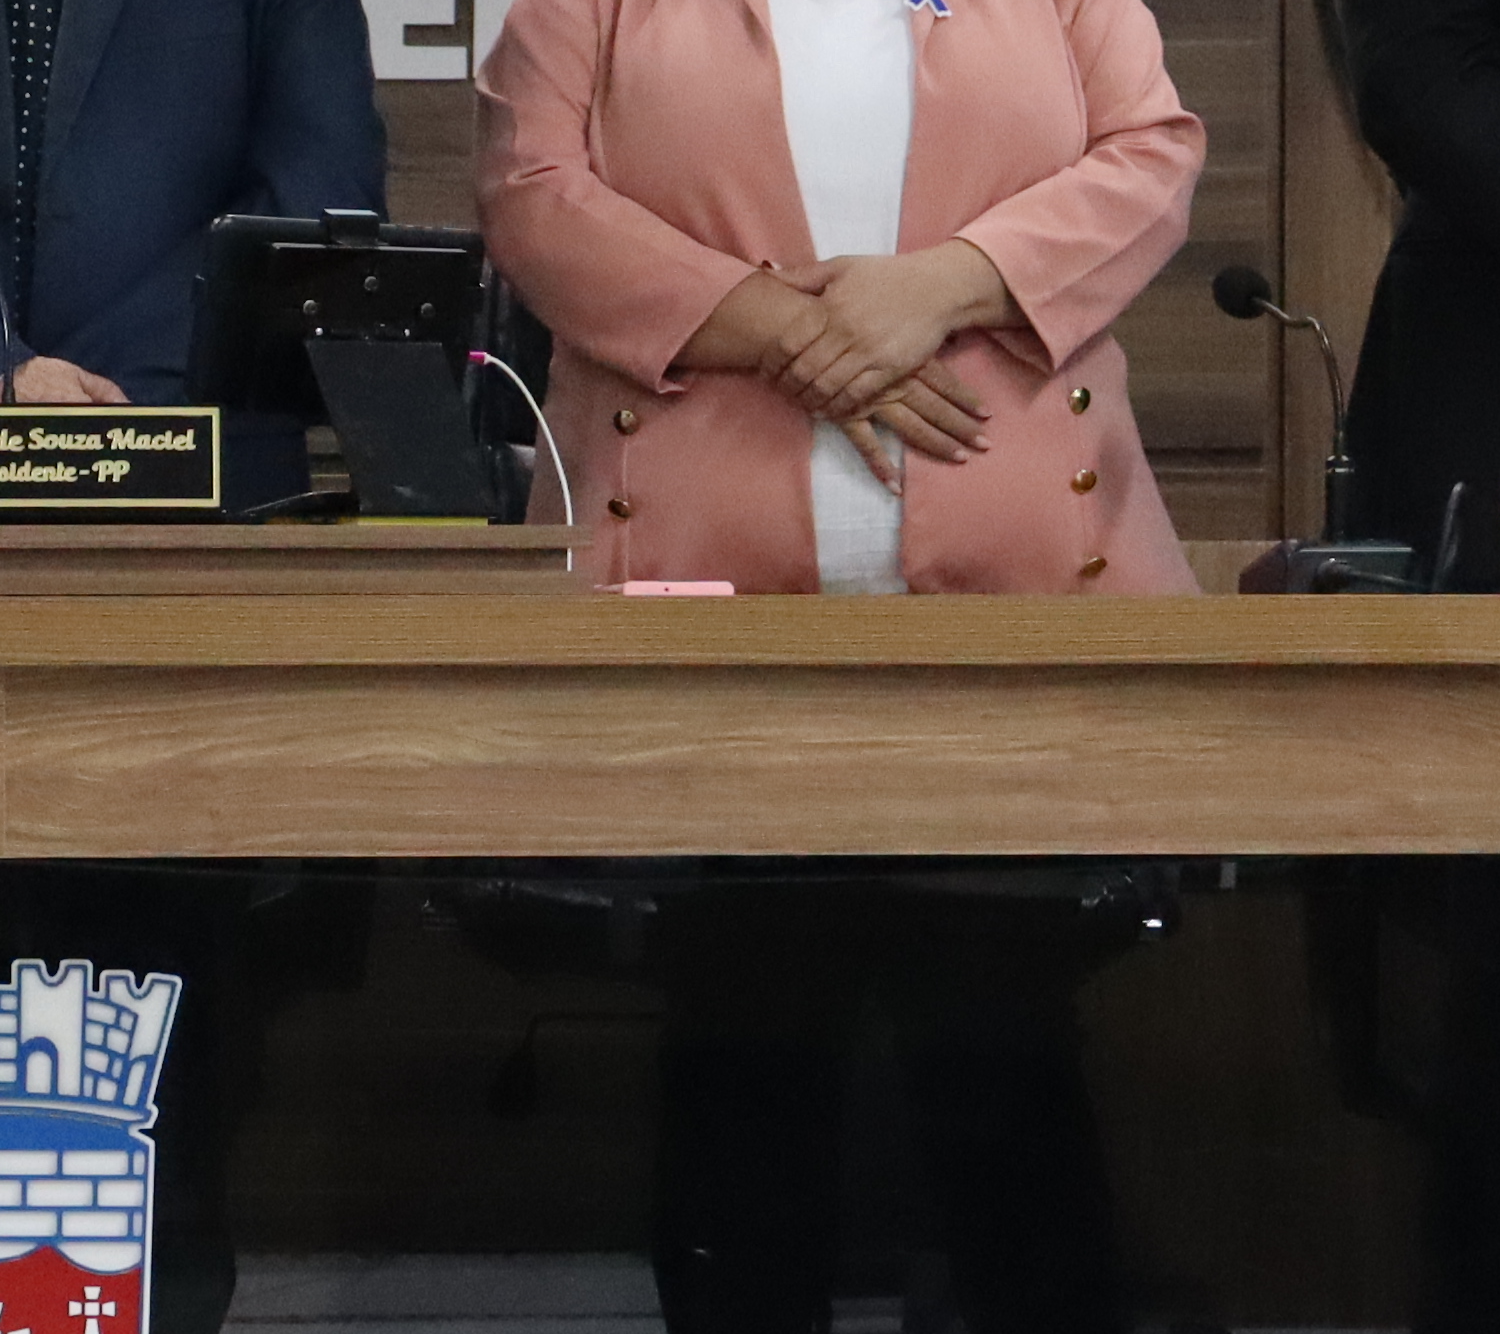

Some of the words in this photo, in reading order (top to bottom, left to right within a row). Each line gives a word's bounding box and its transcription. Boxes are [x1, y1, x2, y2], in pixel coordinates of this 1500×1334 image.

[27, 427, 105, 451] Souza
[106, 427, 197, 451] Maciel
[92, 459, 131, 483] PP
